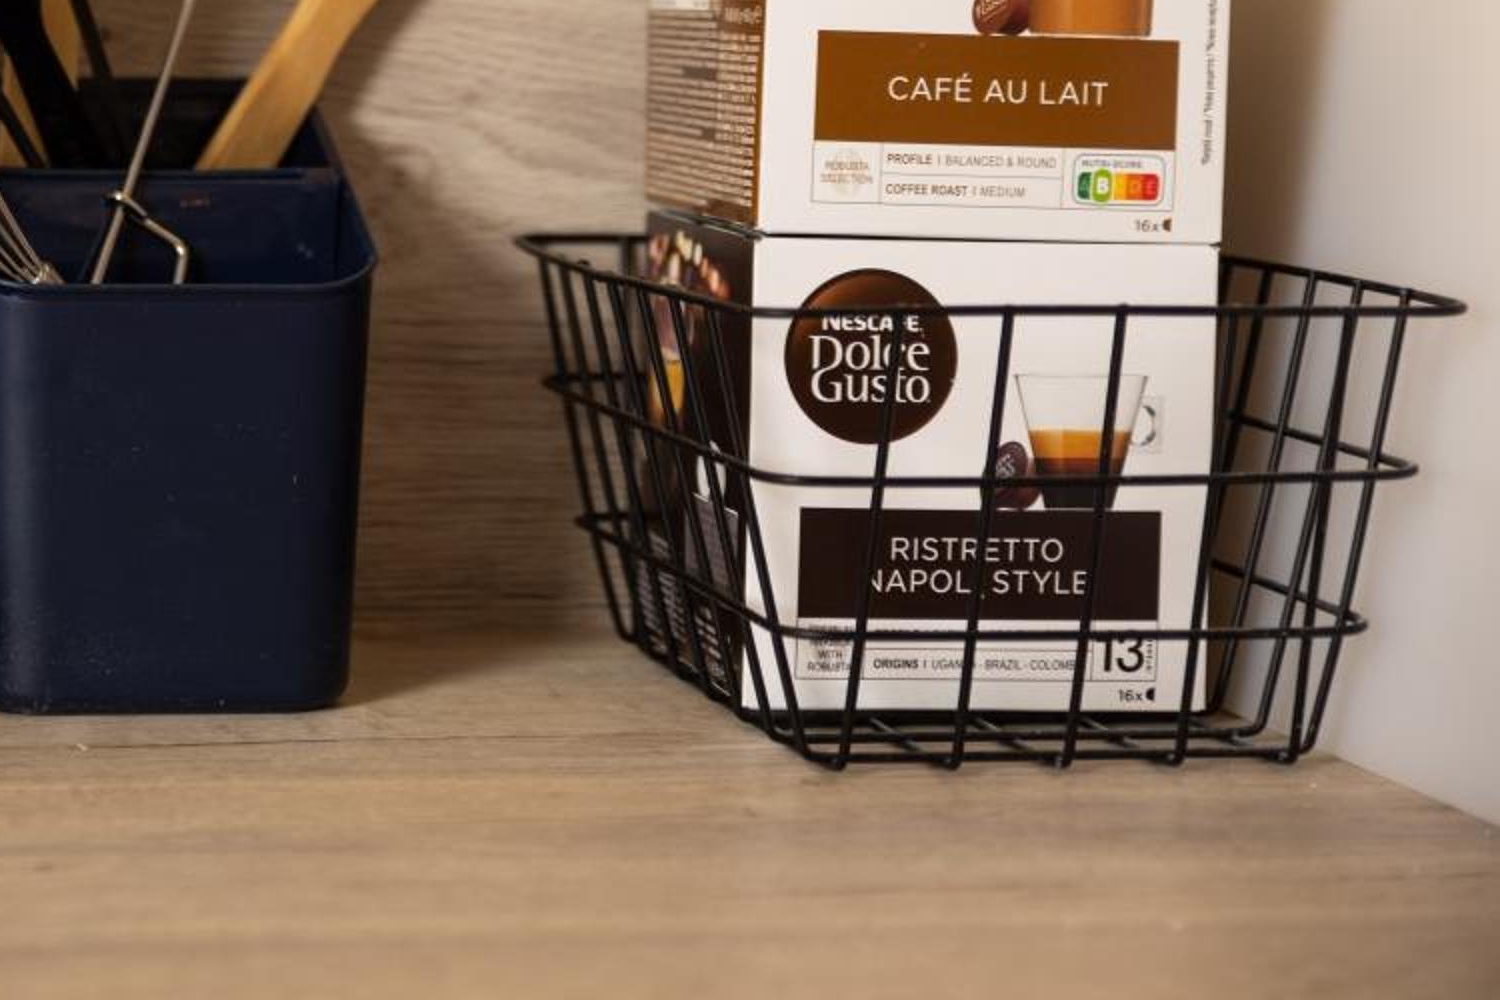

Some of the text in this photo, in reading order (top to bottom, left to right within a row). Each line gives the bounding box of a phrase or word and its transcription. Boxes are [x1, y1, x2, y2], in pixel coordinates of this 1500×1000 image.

[887, 73, 1109, 106] CAFÉ AU LAIT
[887, 153, 932, 165] PROFILE
[945, 155, 1005, 166] BALANCED
[1017, 157, 1057, 168] ROUND
[885, 184, 1025, 197] COFFEE ROAST MEDIUM
[1135, 220, 1158, 232] 16x
[822, 314, 921, 332] NESCAE
[811, 369, 931, 403] Gusto
[891, 537, 1063, 562] RISTRETTO
[871, 569, 1088, 594] NAPOL STYLE
[818, 651, 843, 660] WITH
[873, 659, 919, 670] ORIGINS
[985, 659, 1022, 671] BRAZIL
[1029, 659, 1078, 671] COLOMB
[1119, 689, 1143, 702] 16x
